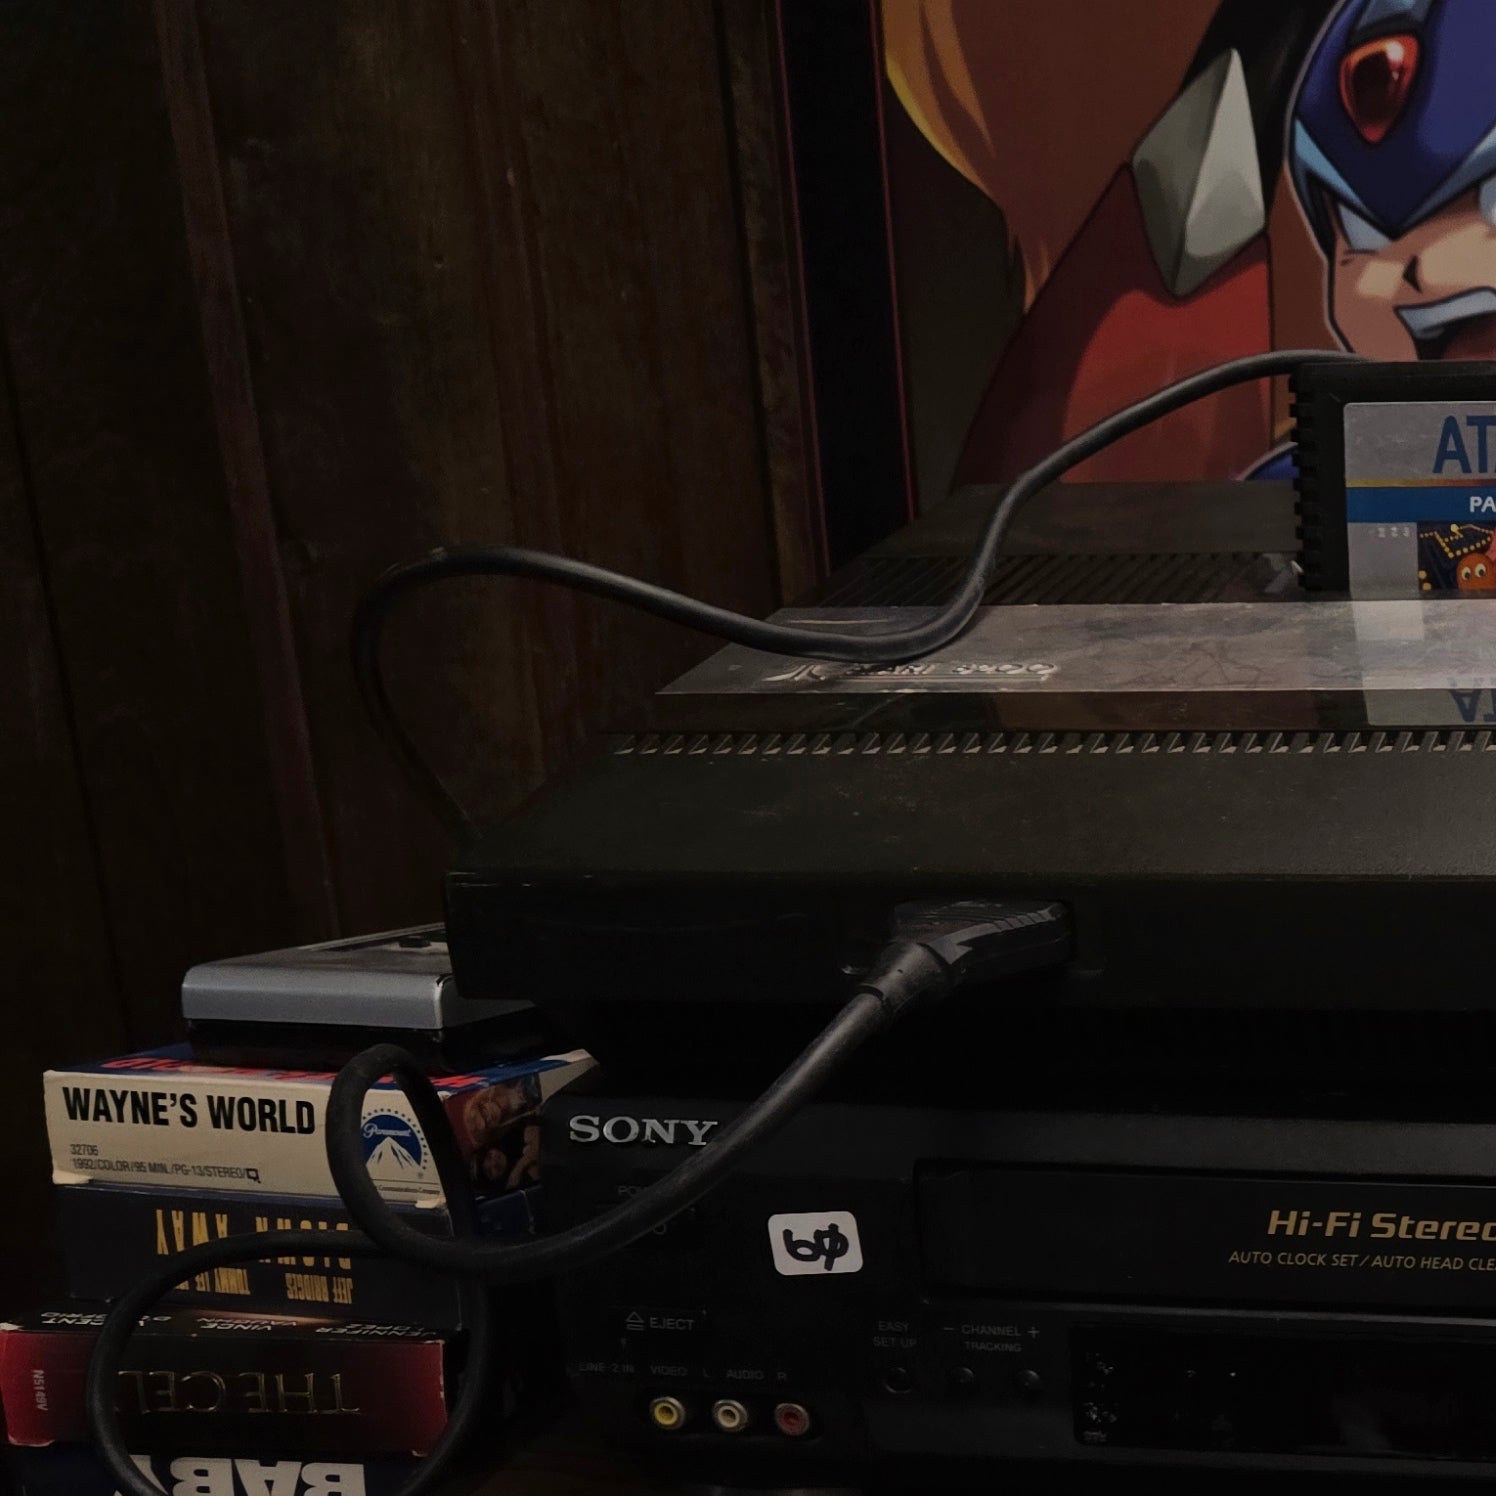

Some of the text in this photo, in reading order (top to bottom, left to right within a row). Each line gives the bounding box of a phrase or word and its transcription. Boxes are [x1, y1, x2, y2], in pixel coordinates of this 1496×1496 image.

[62, 1086, 197, 1127] WAYNE'S
[207, 1095, 316, 1135] WORLD
[569, 1115, 719, 1146] SONY
[1267, 1209, 1360, 1240] Hi-Fi
[1228, 1250, 1272, 1267] AUTO
[1276, 1251, 1328, 1268] CLOCK
[1419, 1255, 1464, 1272] HEAD
[648, 1317, 696, 1332] EJECT
[877, 1320, 911, 1333] EASY
[960, 1324, 1022, 1337] CHANNEL
[872, 1335, 917, 1349] SET UP
[964, 1341, 1023, 1353] TRACKING
[648, 1363, 690, 1377] VIDEO
[725, 1367, 766, 1381] AUDIO
[112, 1368, 361, 1416] THE CEL
